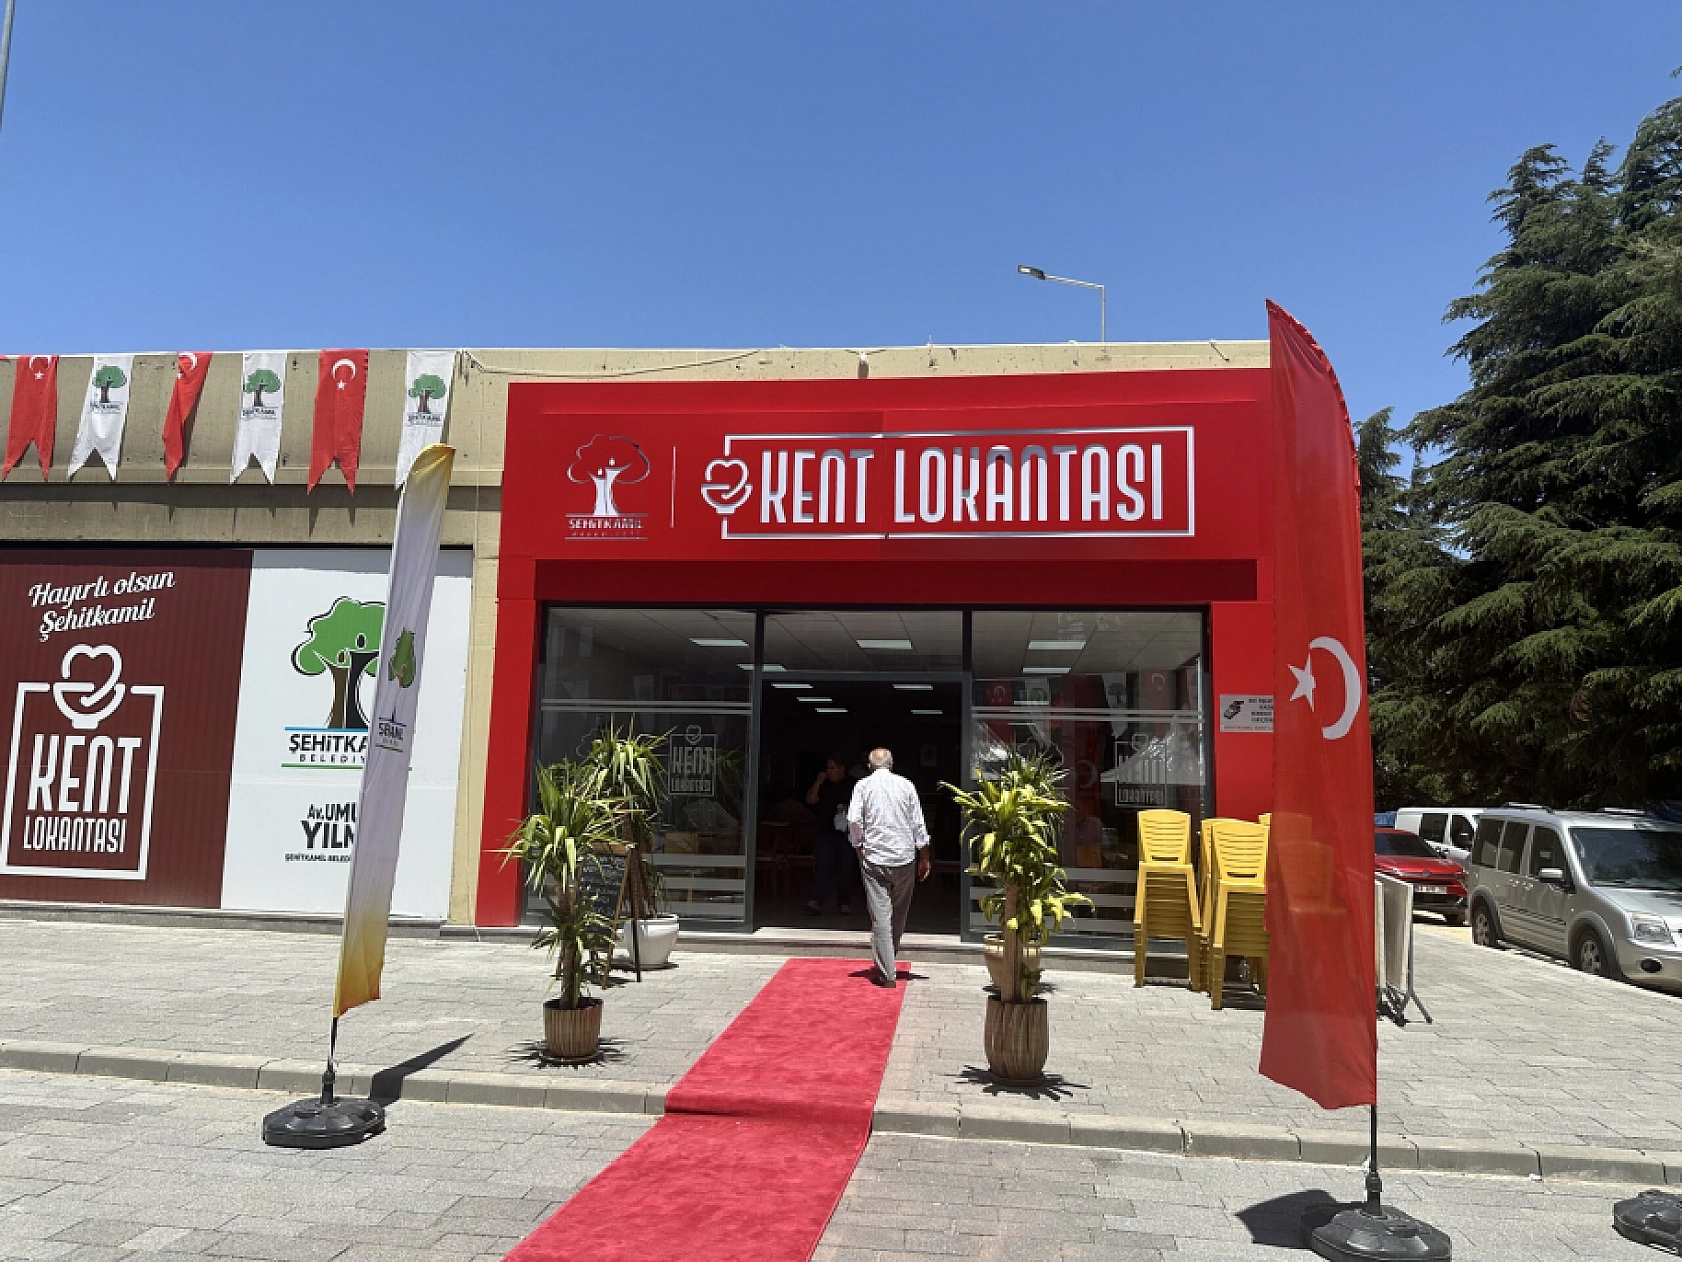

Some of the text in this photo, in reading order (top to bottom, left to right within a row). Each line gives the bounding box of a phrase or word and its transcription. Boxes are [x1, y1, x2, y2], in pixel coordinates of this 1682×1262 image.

[760, 443, 1163, 524] KENT LOKANTASI
[28, 571, 177, 609] Hayırlı olsun
[39, 597, 156, 642] Şehitkamil
[27, 733, 142, 814] KENT
[22, 815, 128, 853] LOKANTASI
